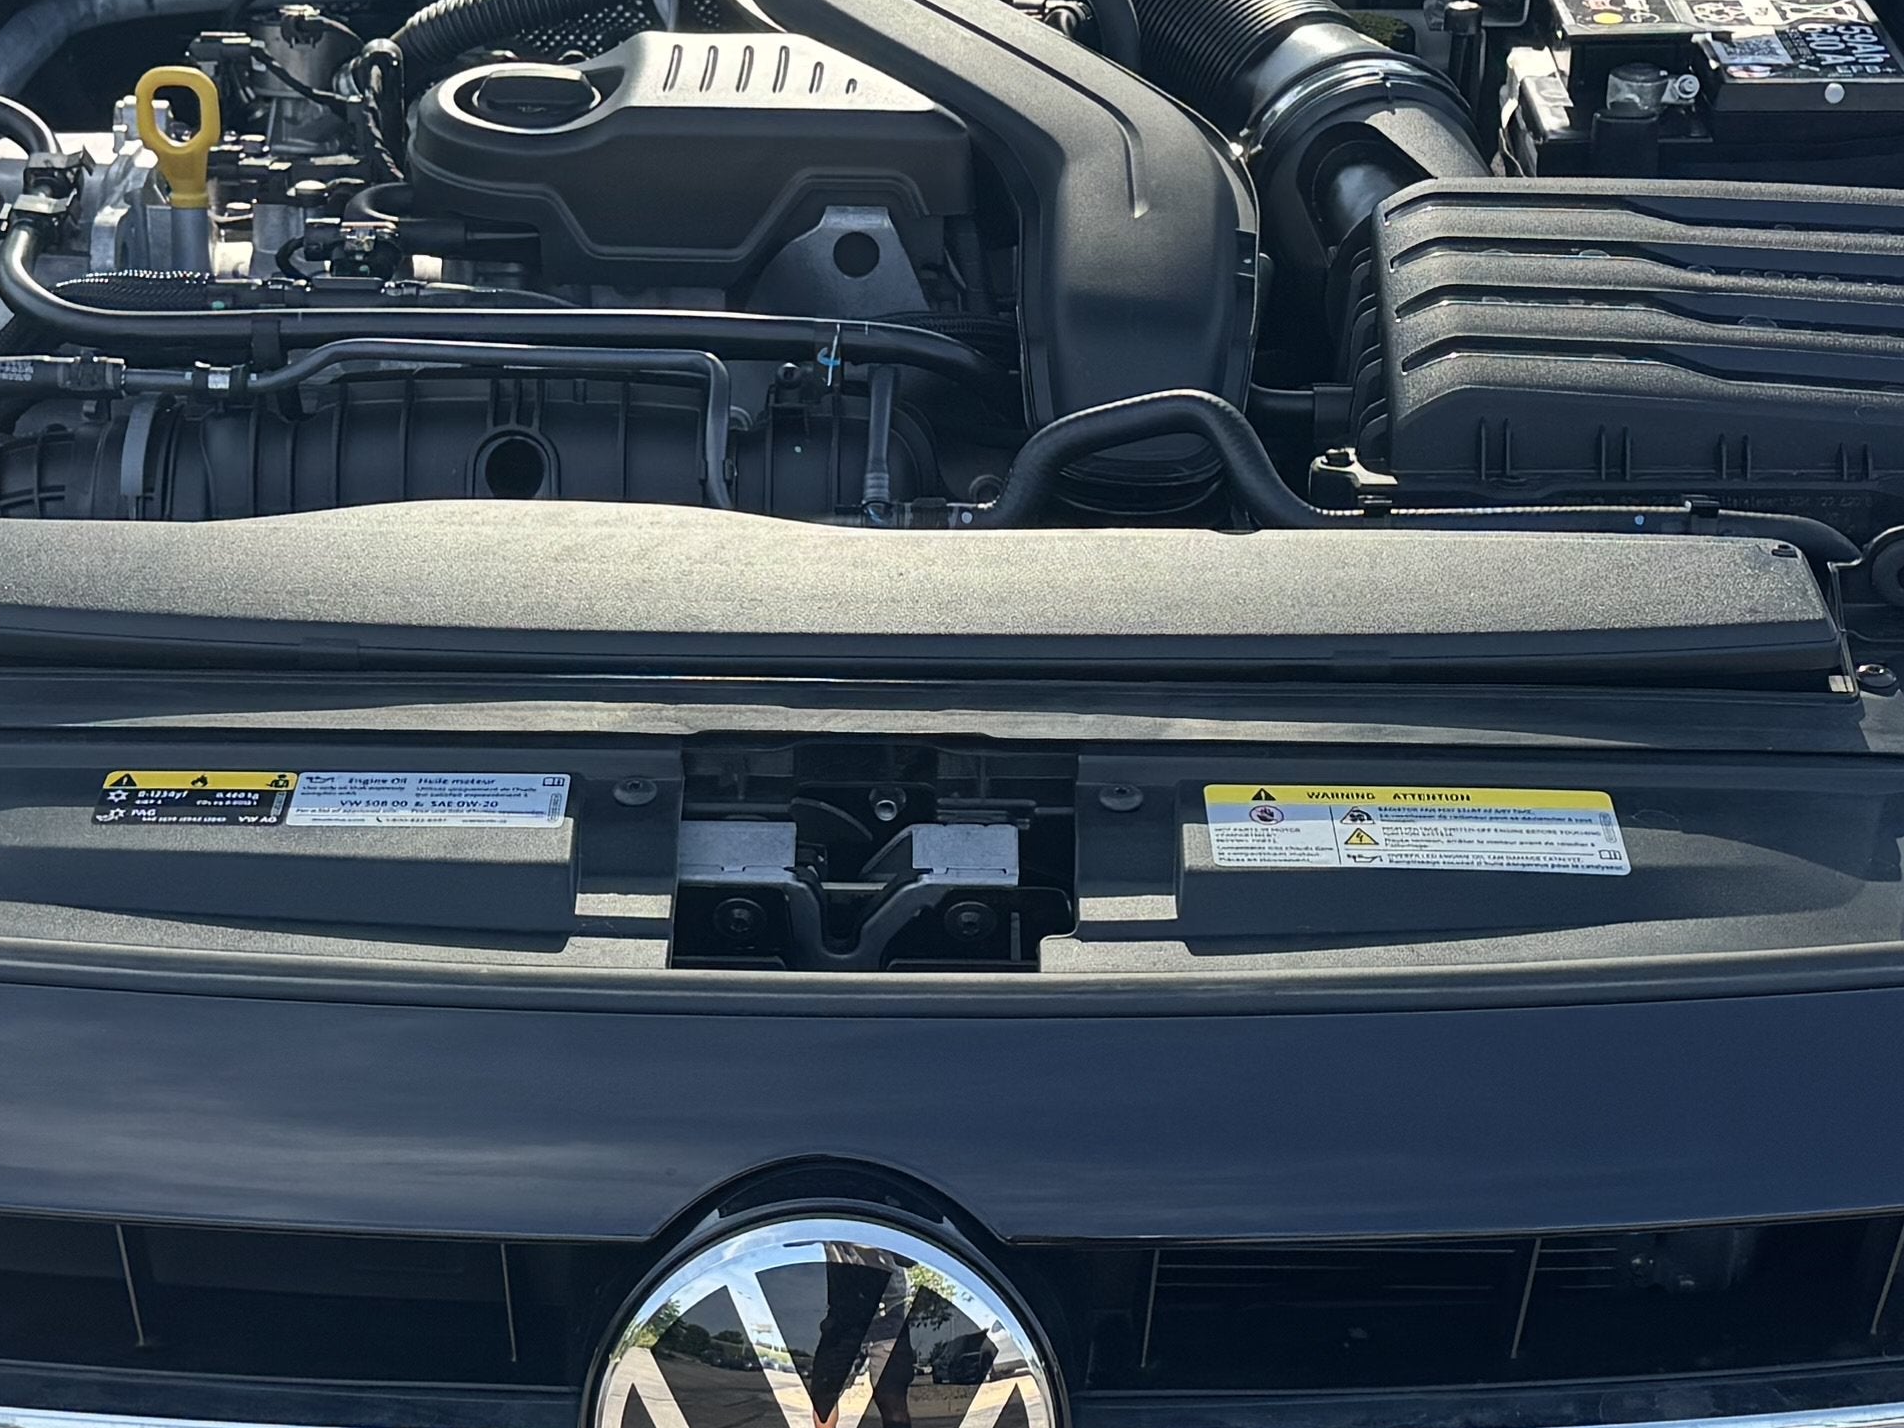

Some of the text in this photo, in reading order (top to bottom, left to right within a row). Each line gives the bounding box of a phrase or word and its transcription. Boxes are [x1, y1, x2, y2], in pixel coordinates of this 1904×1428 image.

[1836, 25, 1891, 63] 59Ah
[1306, 791, 1471, 801] WARNING ATTENTION
